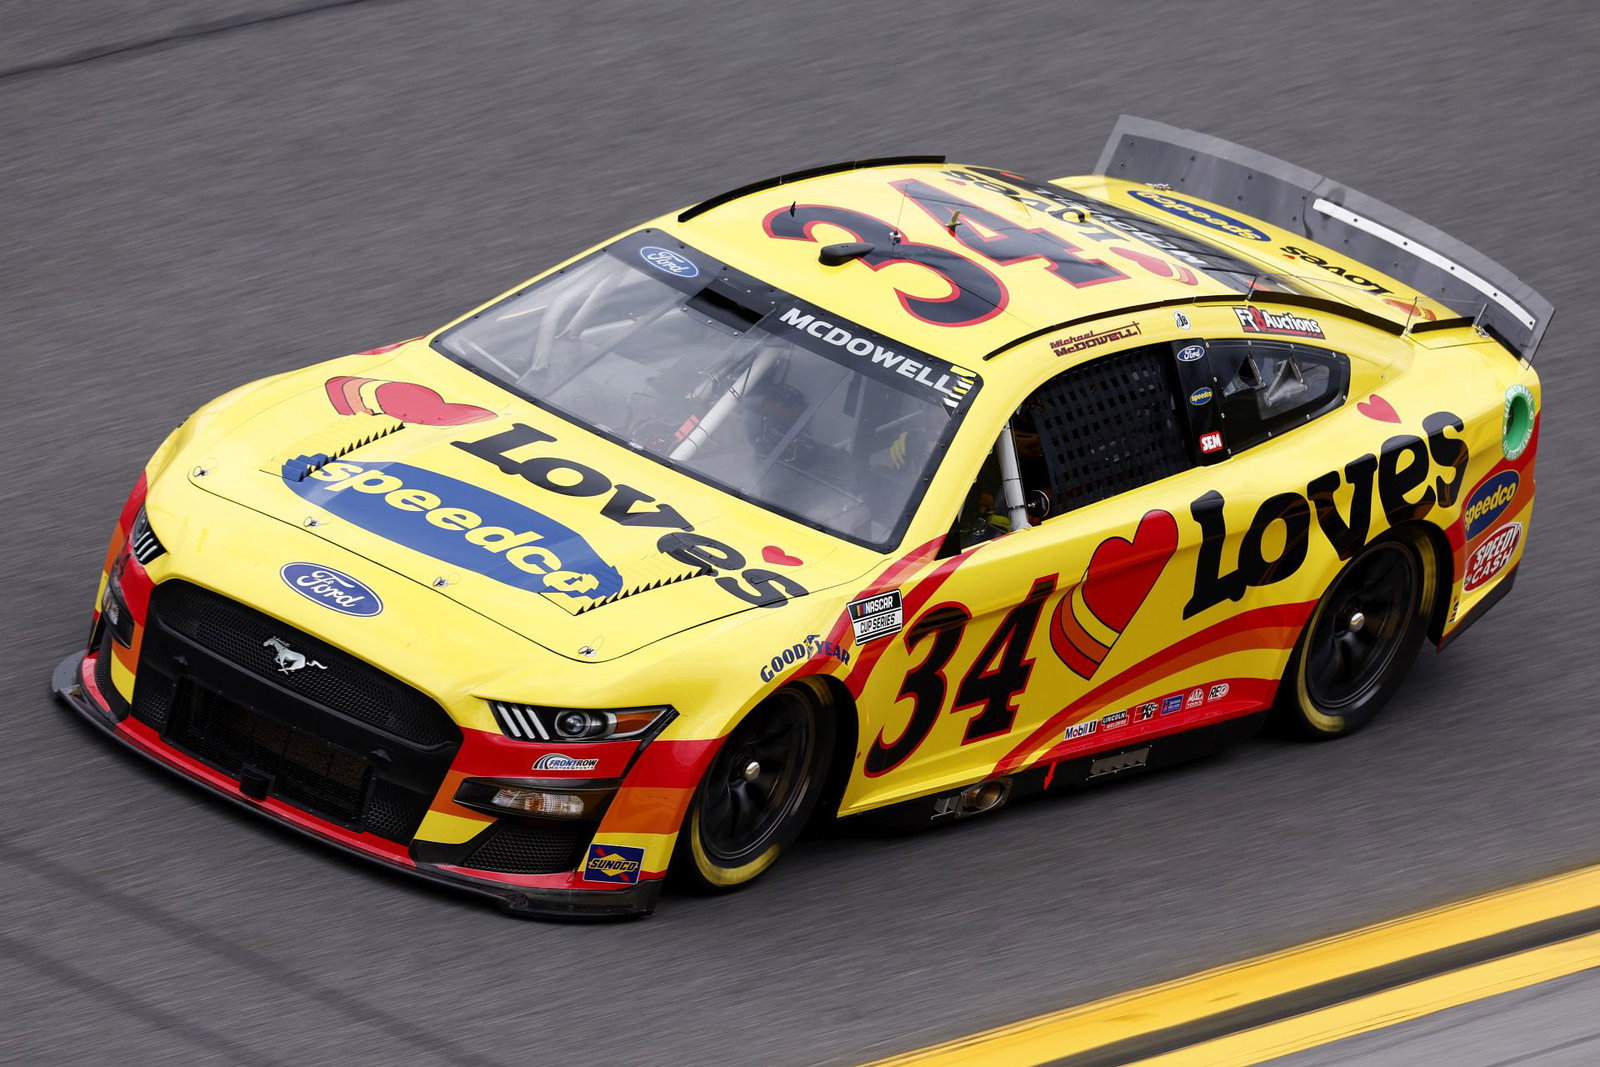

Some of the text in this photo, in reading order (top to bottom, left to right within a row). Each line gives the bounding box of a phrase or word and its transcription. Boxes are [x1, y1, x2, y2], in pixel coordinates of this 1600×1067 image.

[1137, 191, 1262, 241] speedco
[646, 250, 691, 276] Ford
[762, 178, 1131, 328] 34
[779, 307, 955, 395] MCDOWELL
[1049, 331, 1094, 349] Michael
[1201, 433, 1222, 451] SEM
[1464, 482, 1516, 531] speedco
[309, 461, 606, 601] speedco
[1473, 525, 1519, 570] SPEEDY
[1471, 547, 1513, 585] CASH
[307, 569, 360, 609] Ford
[864, 595, 893, 615] NASCAR
[860, 613, 896, 634] CUP SERIES
[865, 573, 1059, 777] 34
[1064, 721, 1096, 739] Mobil 1
[1104, 712, 1126, 723] LINCOLN
[590, 859, 637, 871] SUNOCO
